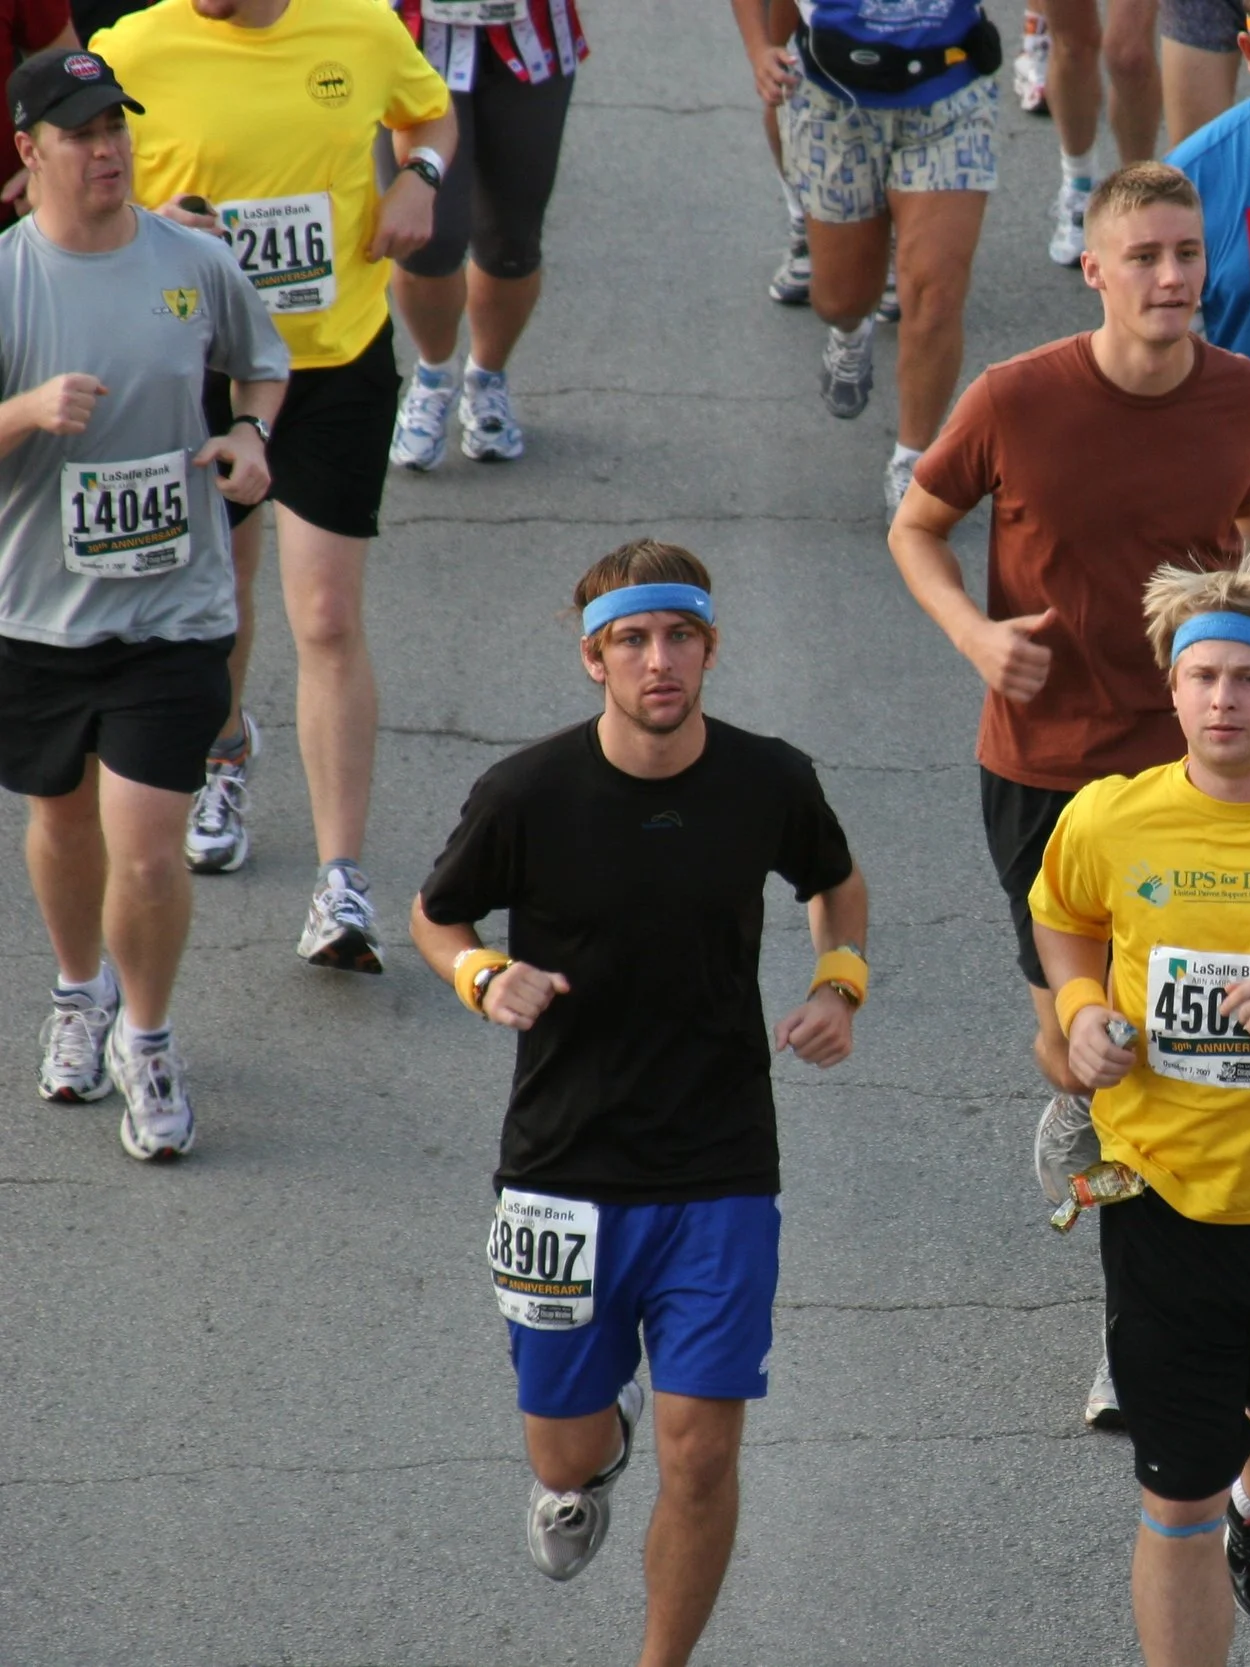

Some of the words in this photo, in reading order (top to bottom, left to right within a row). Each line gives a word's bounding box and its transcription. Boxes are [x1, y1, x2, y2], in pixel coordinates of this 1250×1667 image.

[243, 207, 282, 219] LaSalle
[284, 203, 311, 216] Bank
[102, 469, 142, 482] LaSalle
[145, 464, 170, 478] Bank
[72, 481, 183, 534] 14045
[111, 526, 183, 550] ANNIVERSARY
[1173, 870, 1216, 889] UPS
[1220, 873, 1239, 885] for
[1221, 890, 1249, 901] Support
[1193, 961, 1238, 978] LaSalle
[1171, 1041, 1193, 1052] 30th
[503, 1200, 541, 1218] LaSalle
[544, 1207, 576, 1222] Bank
[508, 1279, 583, 1295] ANNIVERSARY
